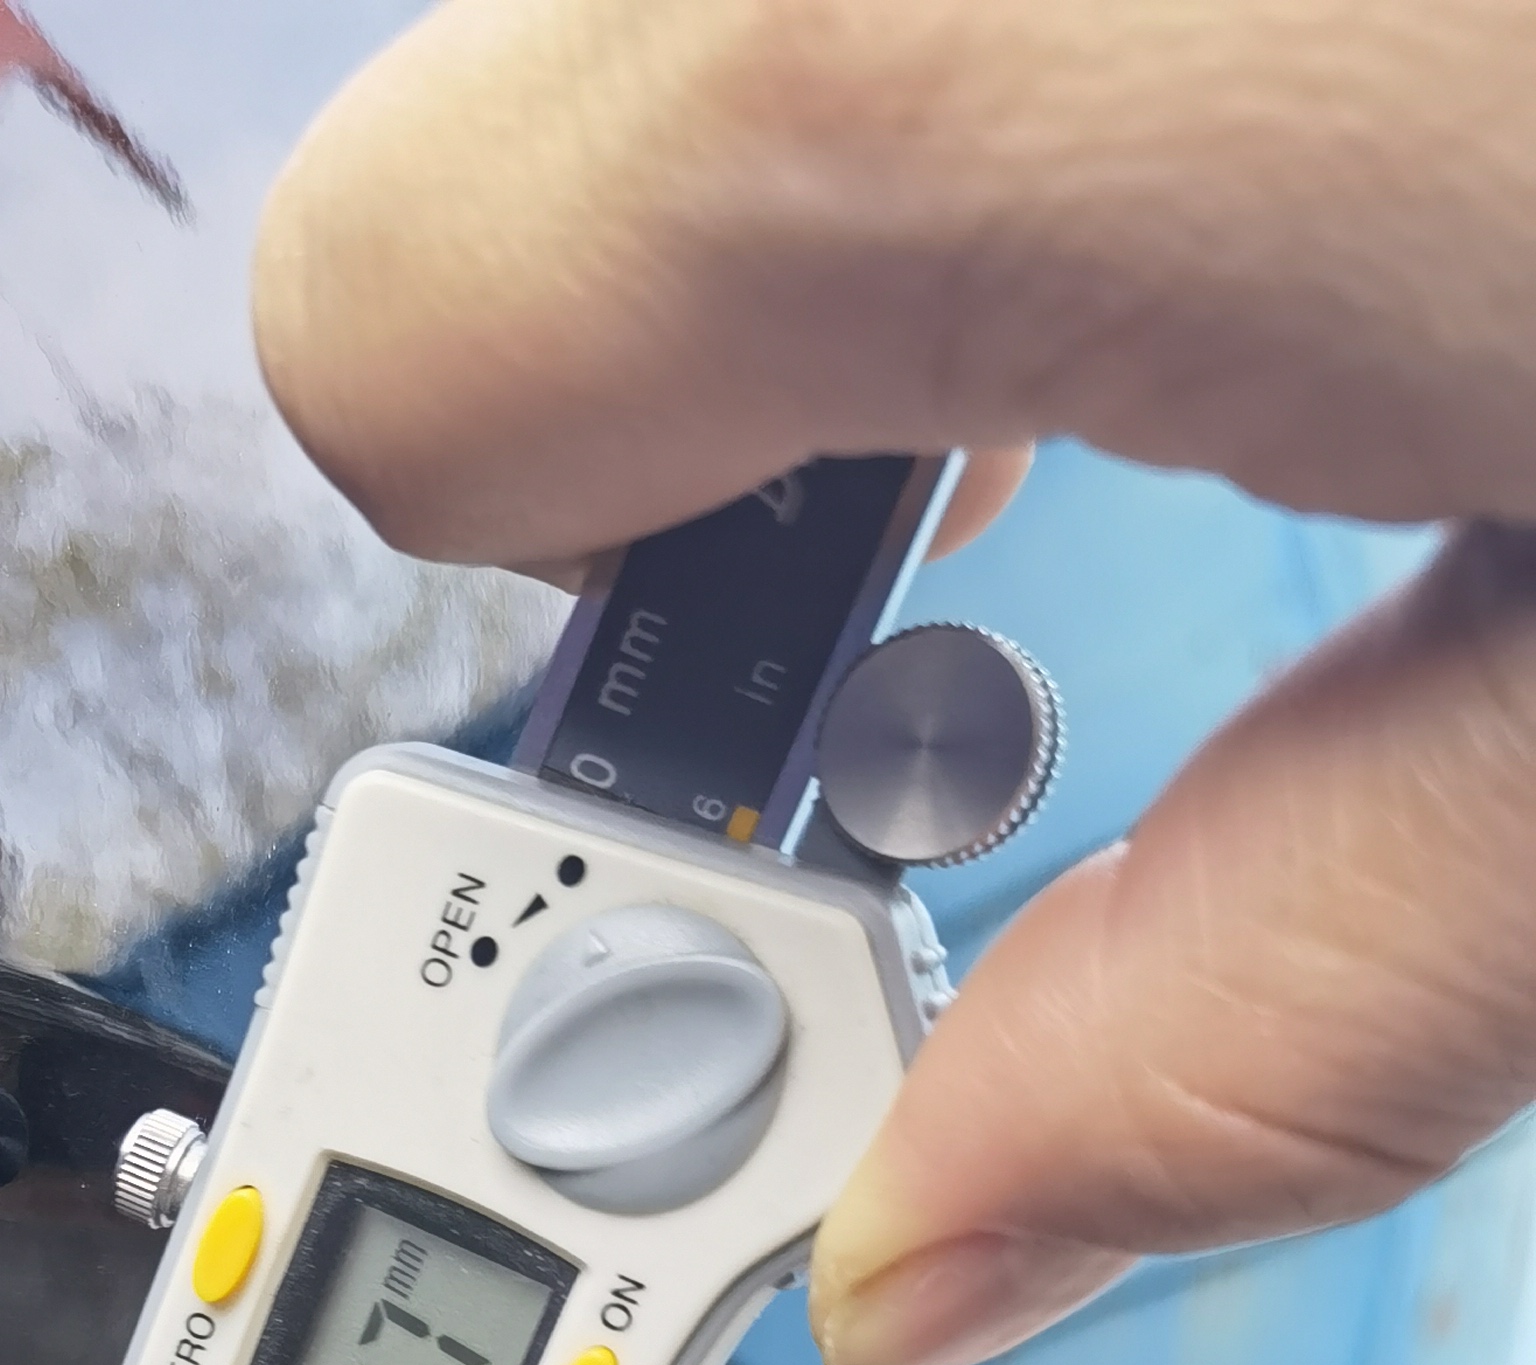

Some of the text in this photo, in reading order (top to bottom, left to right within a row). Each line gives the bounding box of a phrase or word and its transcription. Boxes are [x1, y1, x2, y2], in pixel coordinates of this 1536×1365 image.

[569, 609, 668, 790] 0 mm
[421, 872, 486, 988] OPEN
[382, 1237, 428, 1299] mm
[600, 1273, 646, 1332] ON
